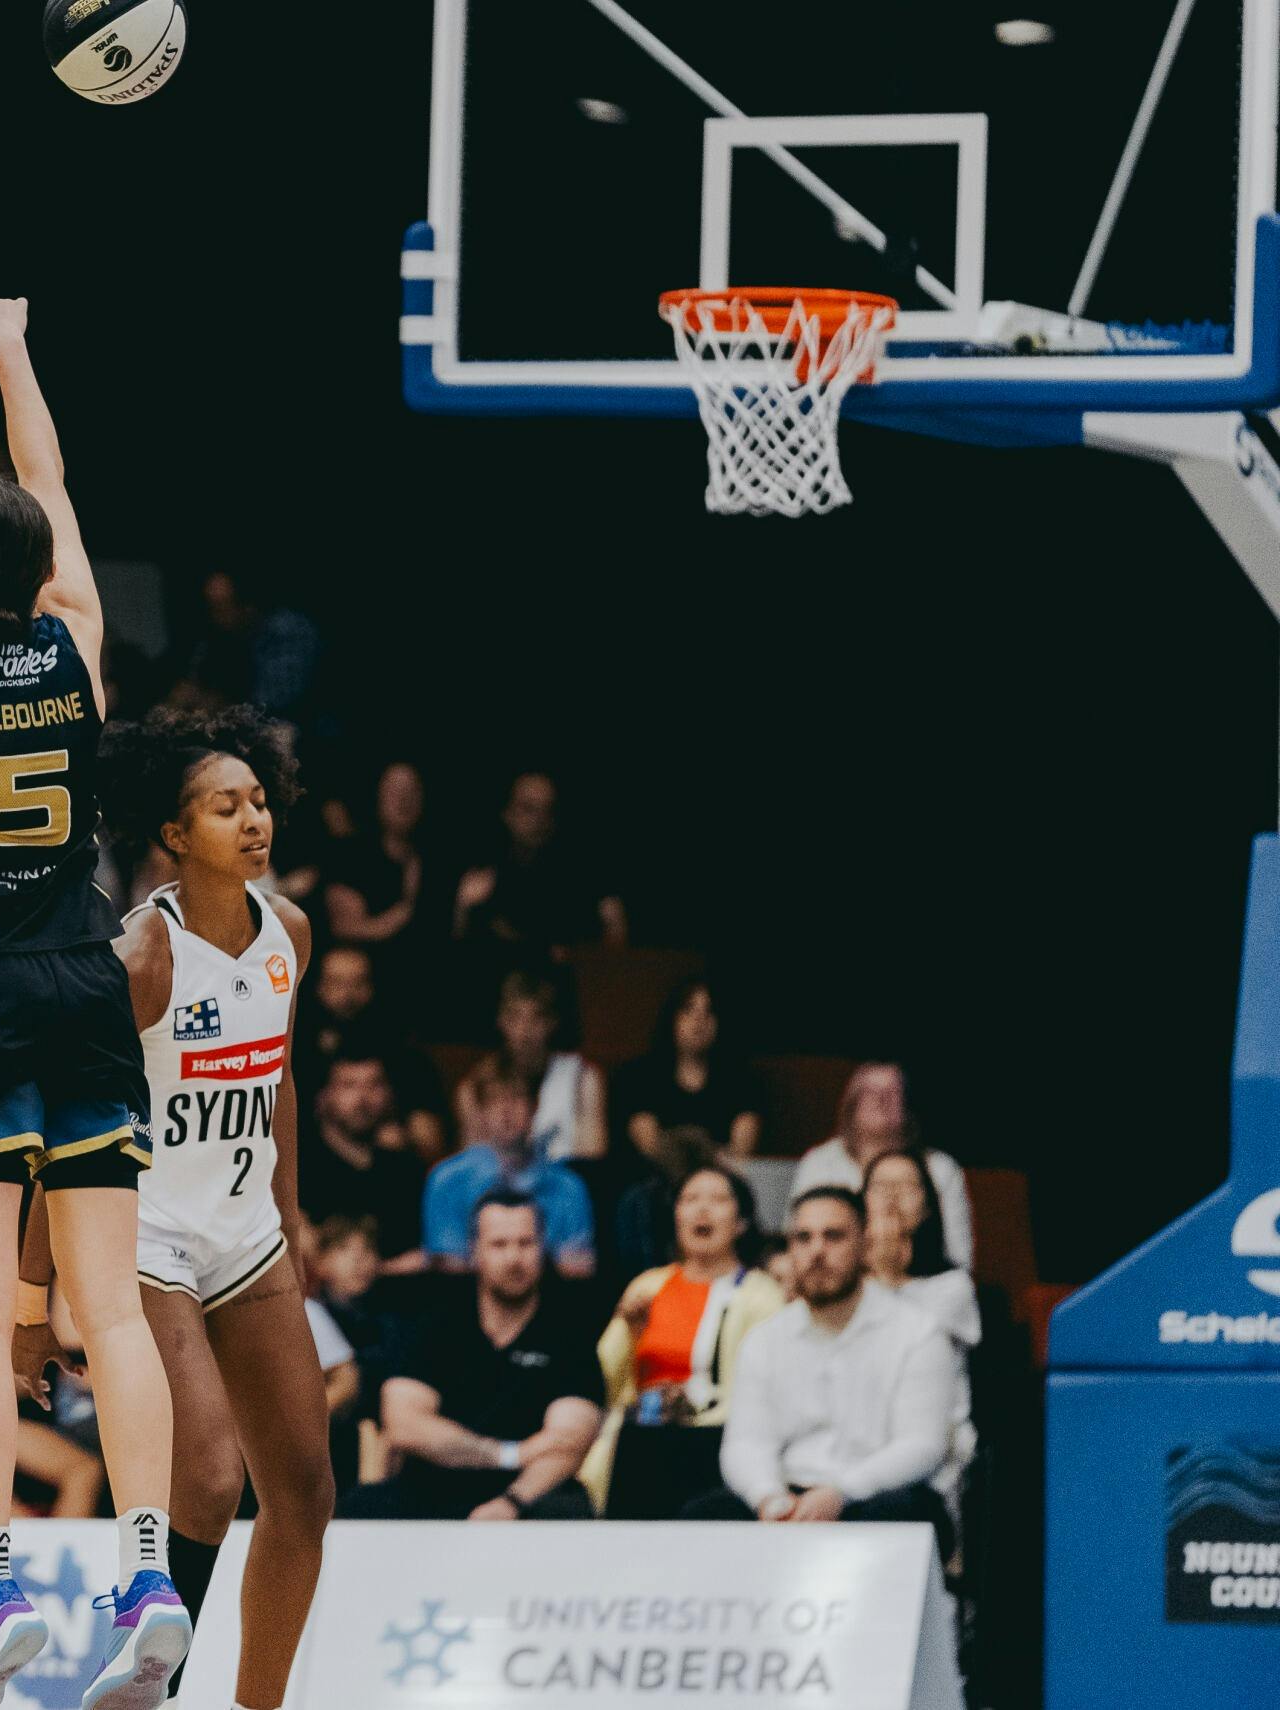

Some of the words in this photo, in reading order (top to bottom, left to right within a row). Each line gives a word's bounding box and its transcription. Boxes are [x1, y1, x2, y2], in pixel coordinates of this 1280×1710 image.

[91, 33, 118, 53] WNBL
[97, 42, 178, 103] SPALDING
[0, 676, 40, 687] DICKSON
[175, 1029, 220, 1040] HOSTPLUS
[191, 1054, 248, 1072] Harvey
[164, 1084, 279, 1148] SYDN
[229, 1147, 253, 1197] 2
[1210, 1576, 1280, 1608] COU
[507, 1597, 771, 1634] UNIVERSITY
[782, 1596, 850, 1636] OF
[502, 1646, 834, 1694] CANBERRA
